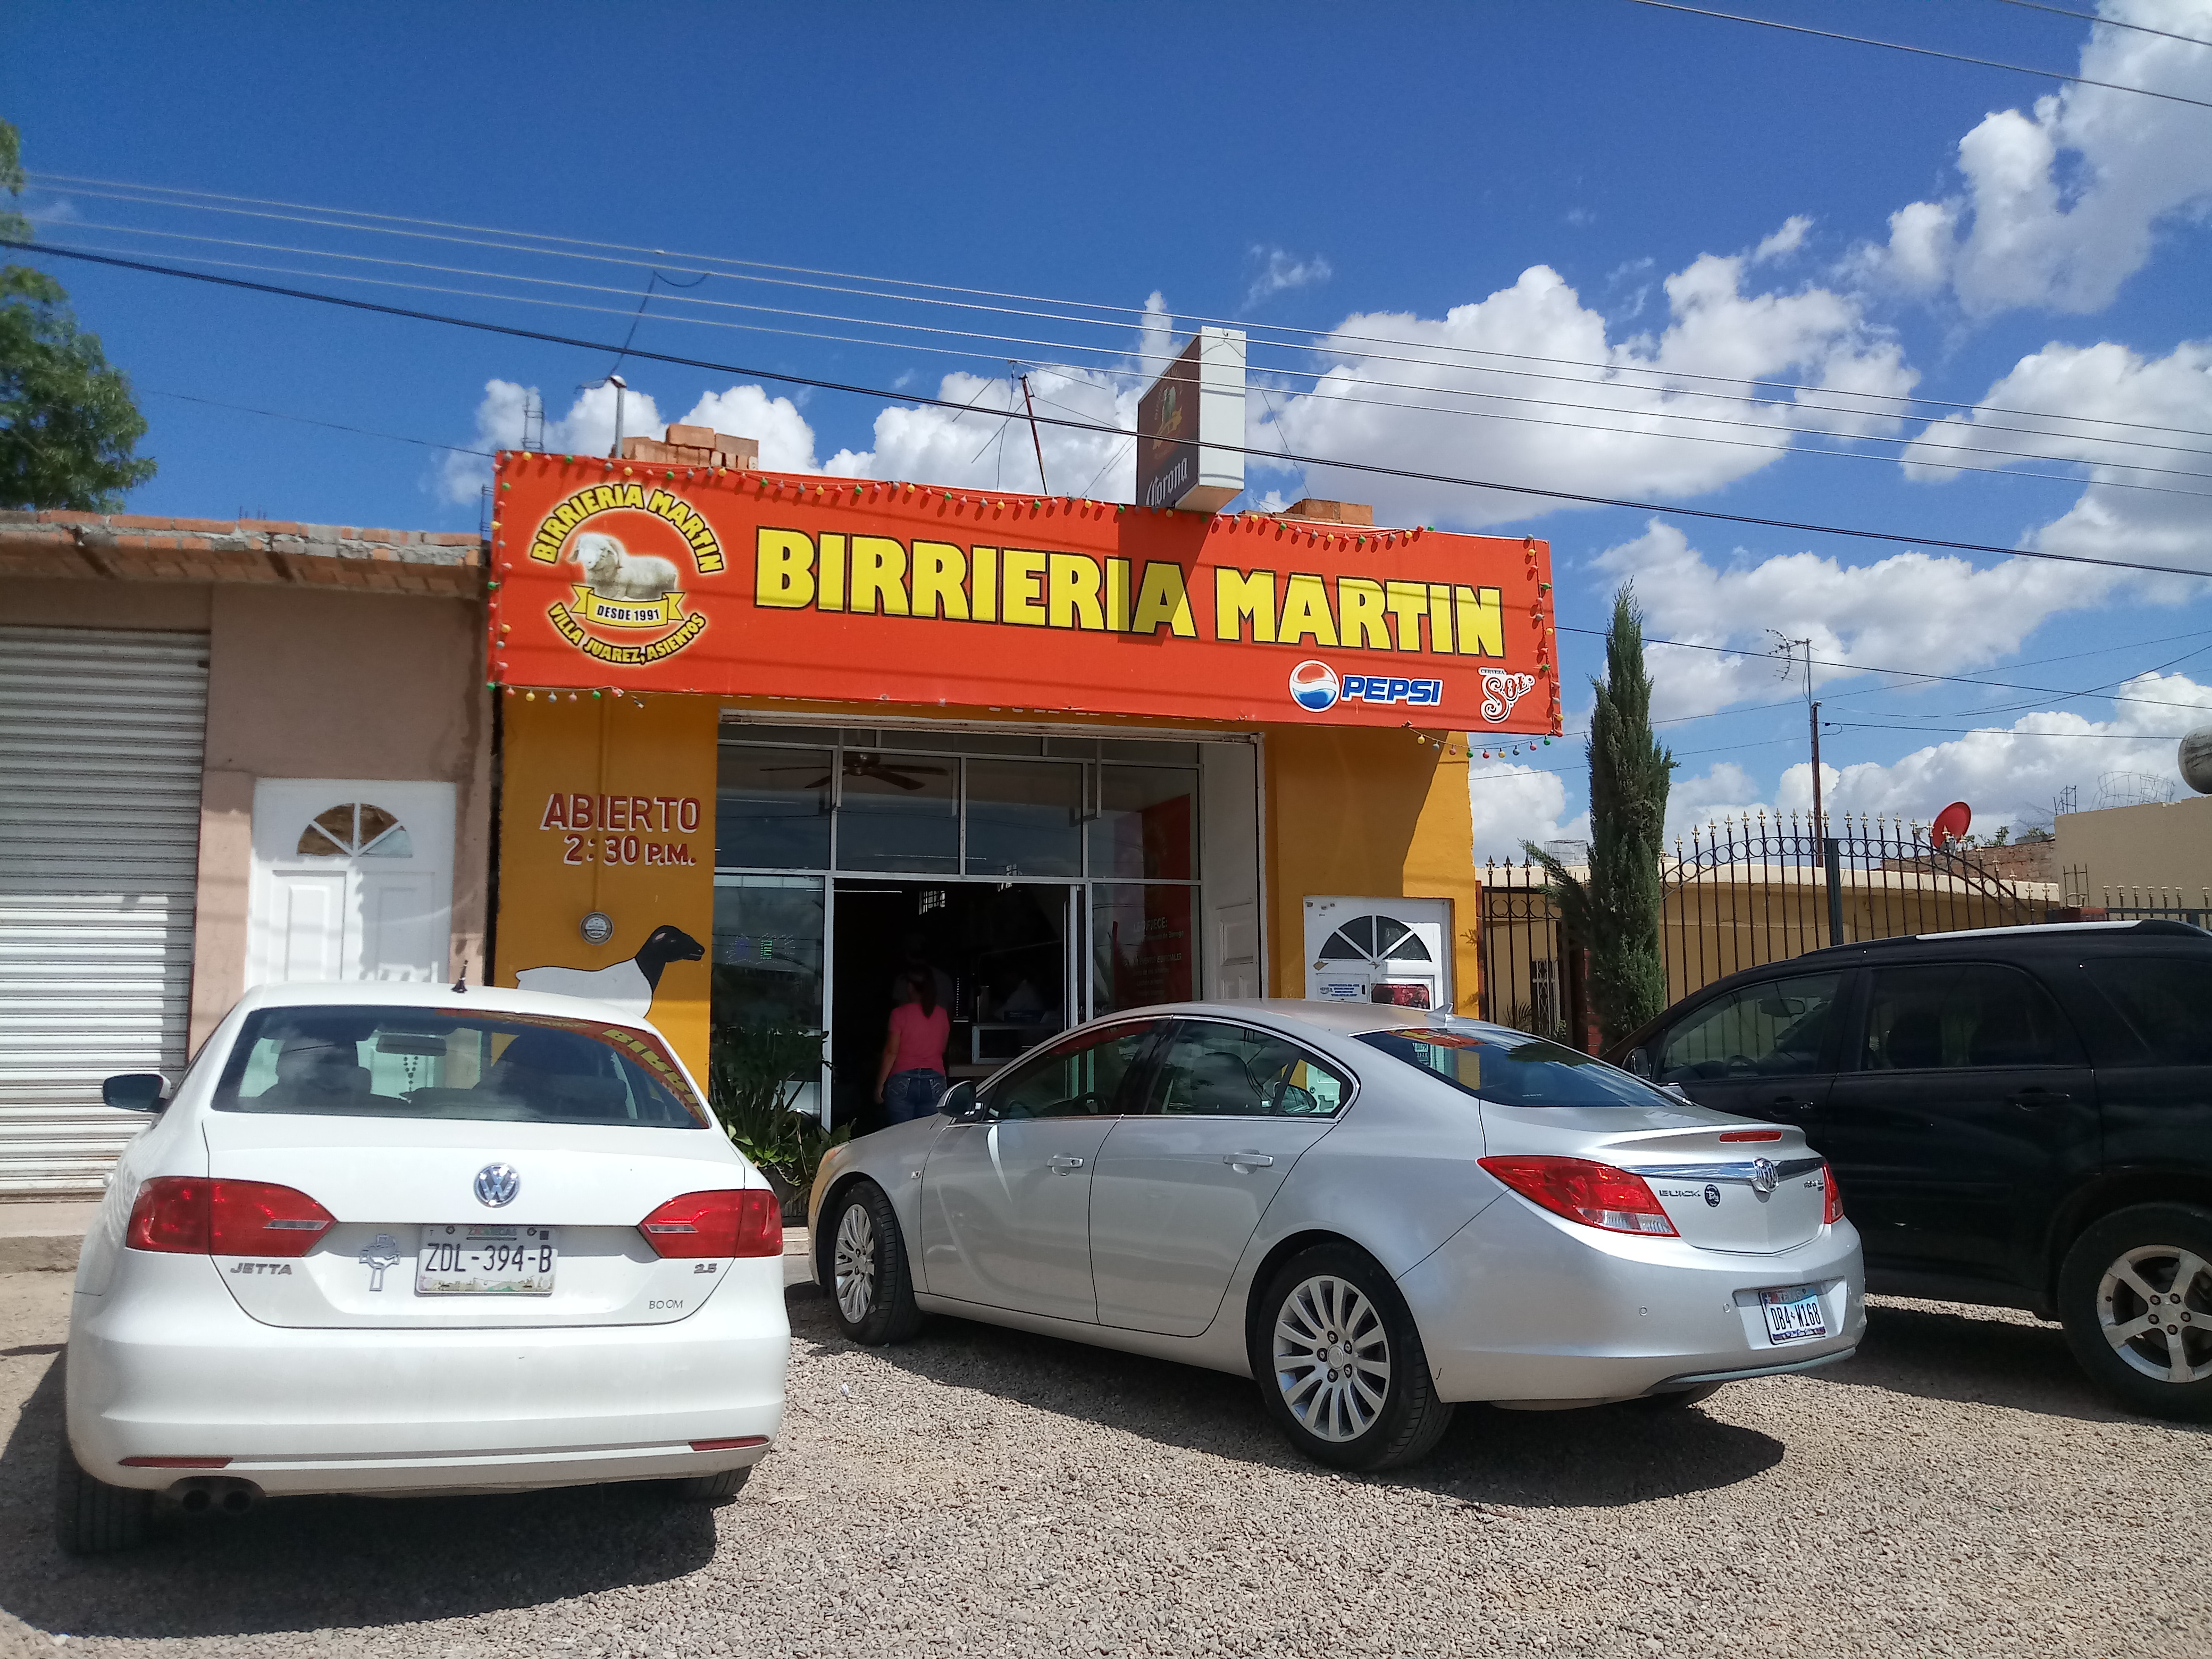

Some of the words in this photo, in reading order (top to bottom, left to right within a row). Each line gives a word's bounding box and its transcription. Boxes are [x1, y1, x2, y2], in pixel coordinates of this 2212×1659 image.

[1146, 457, 1187, 506] Corona
[530, 484, 644, 564] BIRRIERIA
[647, 489, 724, 573] MARTIN
[754, 525, 1199, 638] BIRRIERIA
[1213, 565, 1506, 659] MARTIN
[597, 605, 631, 621] DESDE
[634, 608, 660, 621] 1991
[548, 602, 585, 646] VILLA
[645, 612, 707, 661] ASIENTOS
[1341, 675, 1442, 703] PEPSI
[540, 793, 700, 833] ABIERTO
[644, 842, 697, 866] P.M.
[230, 1262, 292, 1275] JETTA
[425, 1243, 552, 1272] ZDL-394-B
[649, 1300, 683, 1309] BOOM
